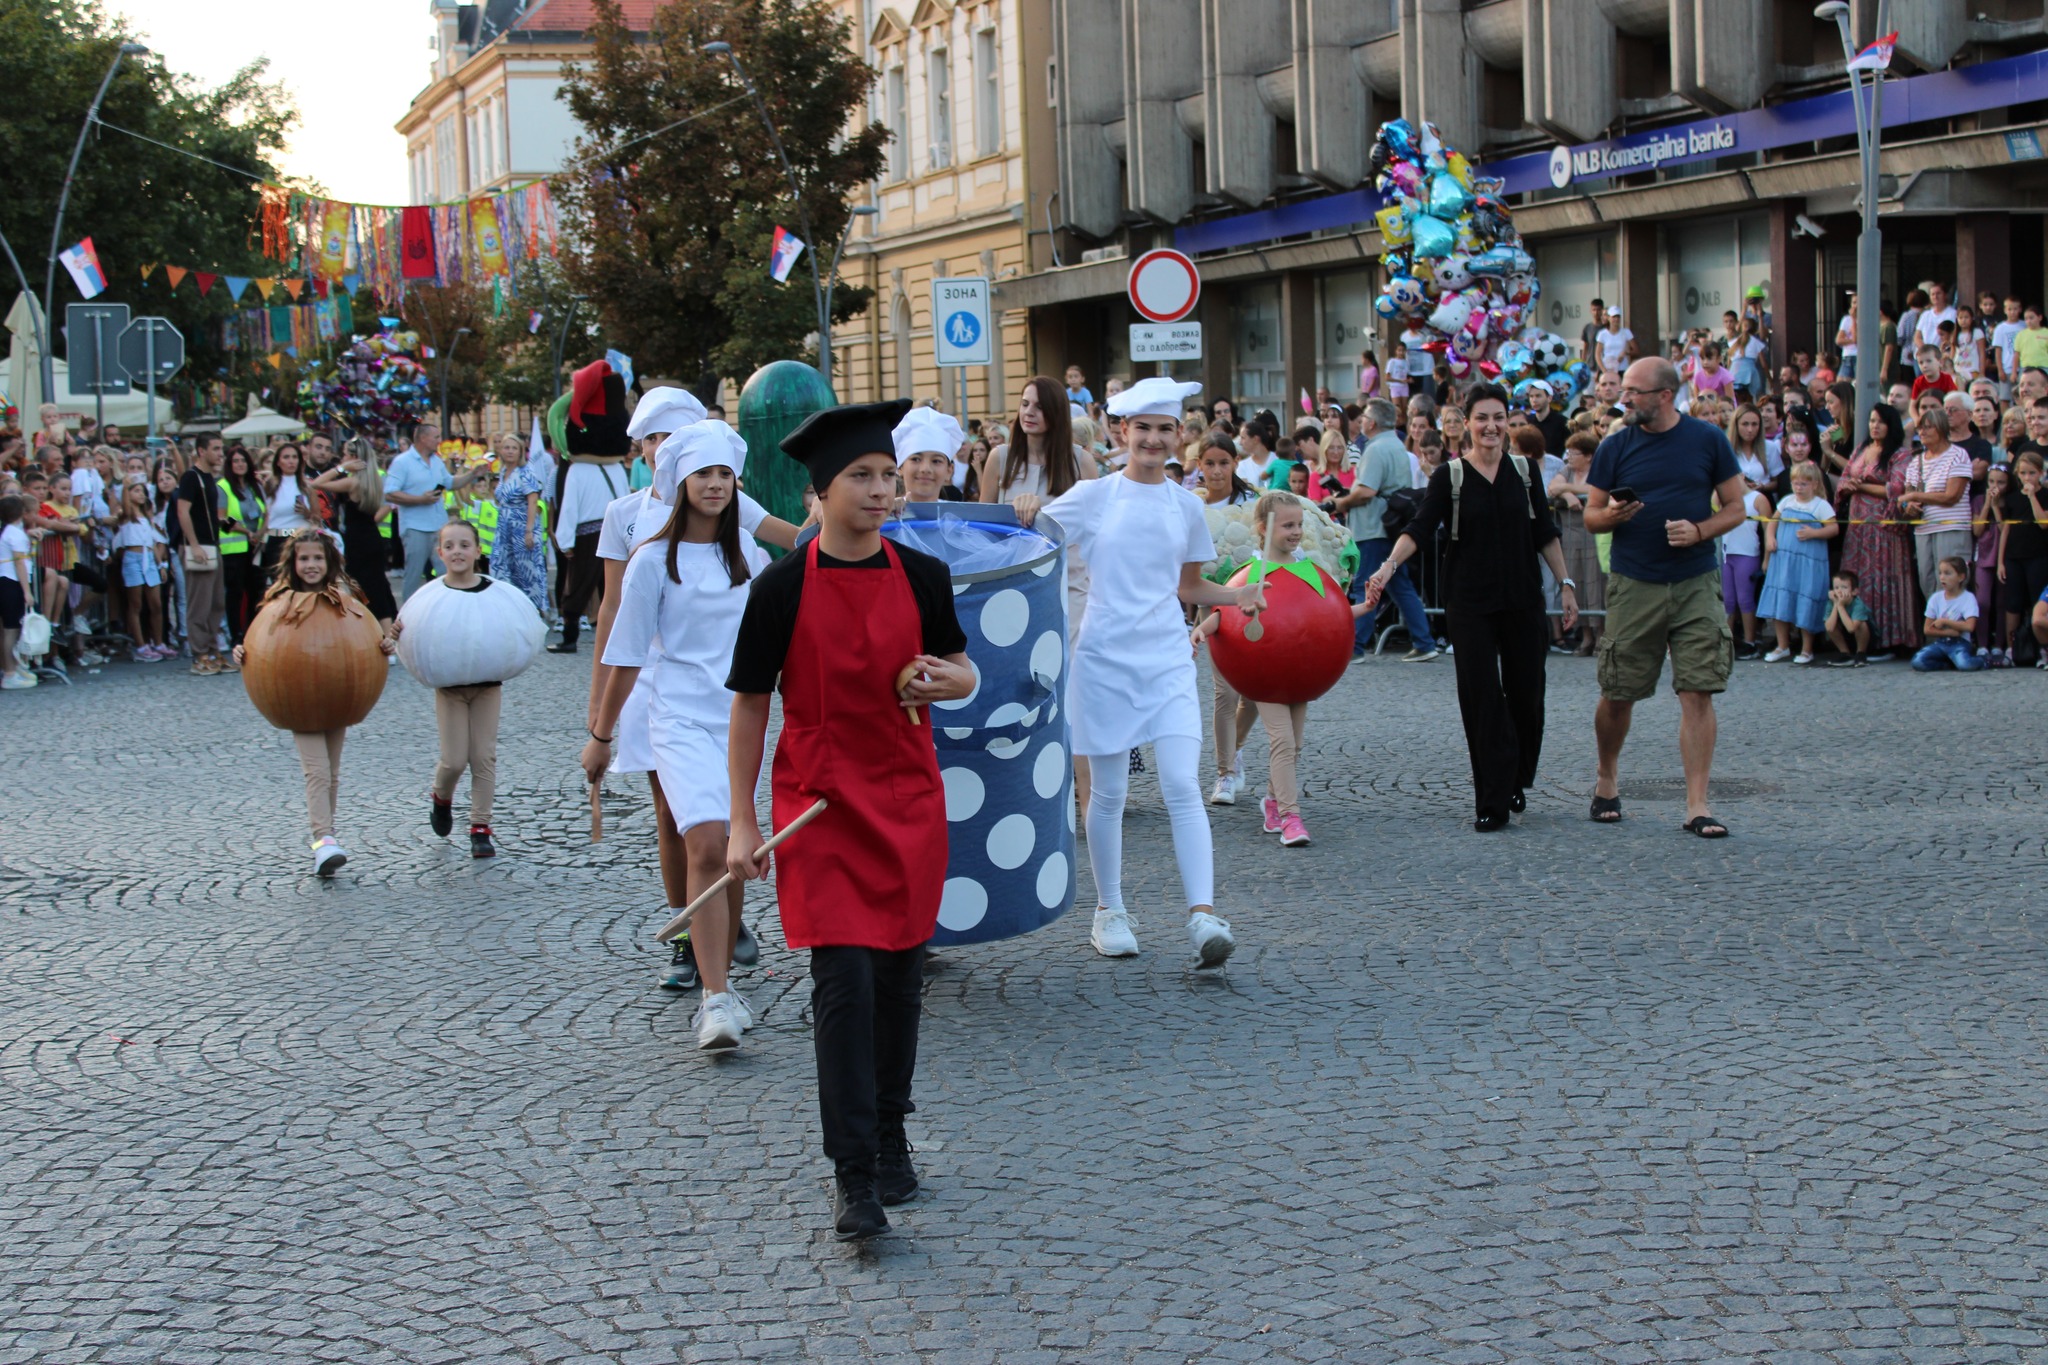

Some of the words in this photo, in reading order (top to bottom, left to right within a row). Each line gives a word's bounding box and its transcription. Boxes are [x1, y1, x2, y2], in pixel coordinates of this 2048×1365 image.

[1573, 149, 1600, 176] NLB
[1601, 133, 1687, 171] Komercijalna
[1689, 122, 1735, 154] banka
[944, 288, 978, 300] ЗОНА
[1701, 291, 1721, 307] NLB
[1565, 304, 1581, 319] NLB
[1150, 341, 1197, 354] одобрем
